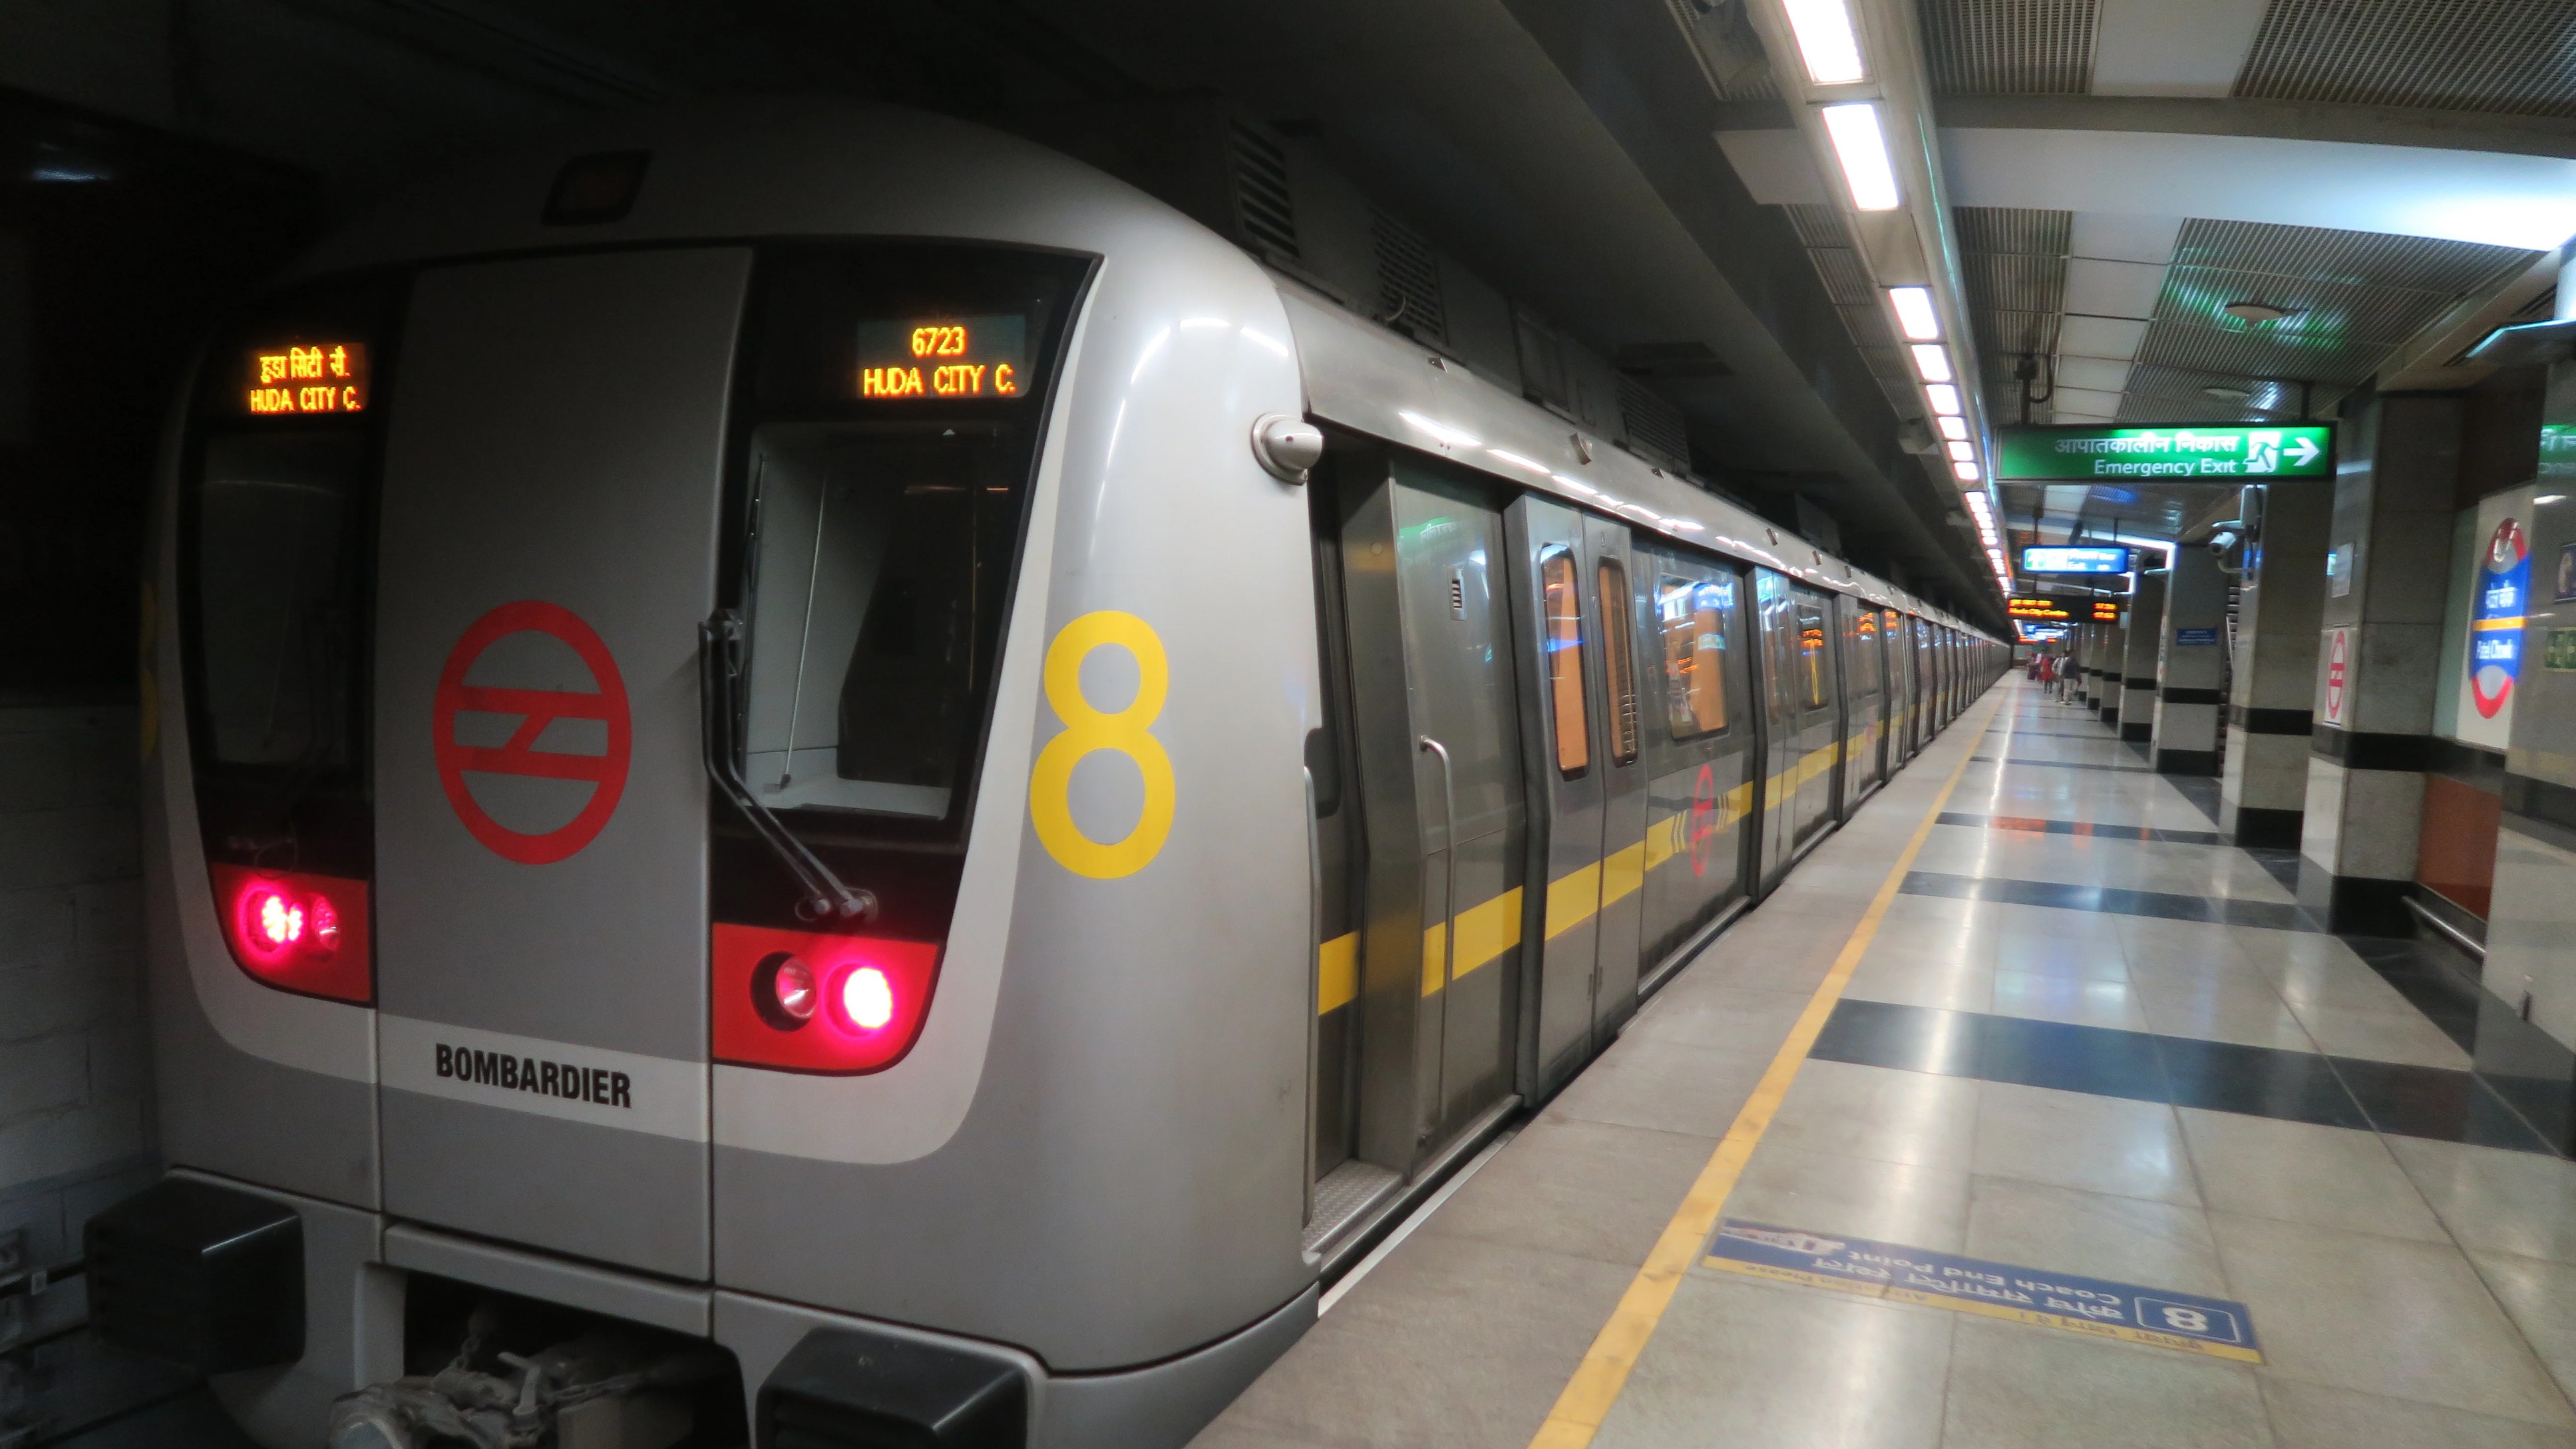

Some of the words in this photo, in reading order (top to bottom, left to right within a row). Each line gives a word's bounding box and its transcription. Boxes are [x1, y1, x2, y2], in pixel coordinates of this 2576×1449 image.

[912, 325, 967, 357] 6723
[289, 346, 325, 379] सिटी
[863, 366, 925, 397] HUDA
[934, 364, 986, 395] CITY
[994, 363, 1017, 395] C.
[250, 388, 296, 413] HUDA
[299, 386, 338, 412] CITY
[342, 385, 362, 412] C.
[2054, 431, 2172, 454] आपातकालीन
[2173, 431, 2241, 453] निकास
[2094, 459, 2195, 477] Emergency
[2200, 458, 2237, 474] Exit
[1029, 610, 1176, 879] 8
[436, 1042, 632, 1109] BOMBARDIER
[1815, 1257, 1890, 1279] स्थल
[1847, 1251, 1932, 1272] Point
[1942, 1267, 2004, 1285] End
[2015, 1279, 2121, 1305] Coach
[2046, 1296, 2124, 1321] कोच
[2161, 1307, 2209, 1333] 8
